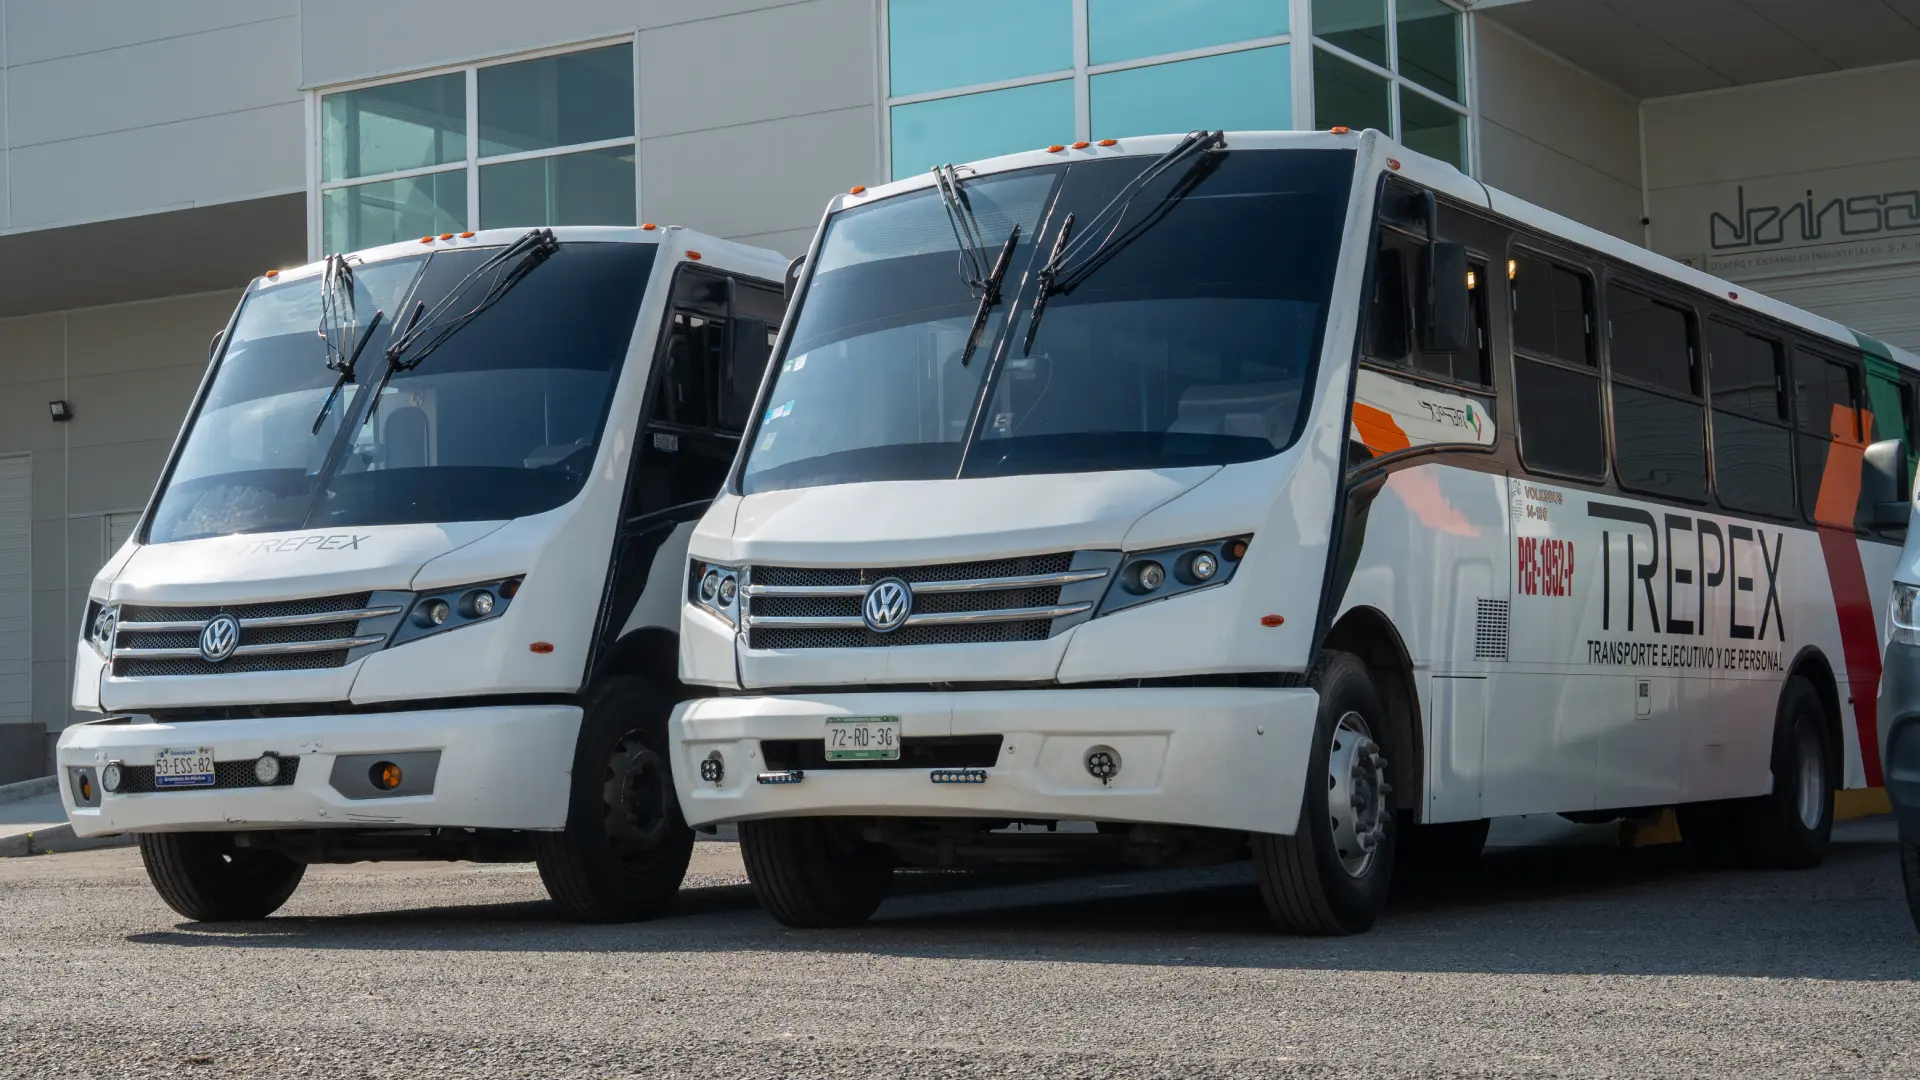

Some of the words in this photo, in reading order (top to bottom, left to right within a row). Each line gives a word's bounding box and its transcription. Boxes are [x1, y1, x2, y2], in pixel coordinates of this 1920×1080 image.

[1524, 485, 1563, 505] VOLKSBUS
[237, 534, 373, 556] TREPEX
[1518, 536, 1575, 597] PCE-1952-P
[1587, 501, 1786, 642] TREPEX
[1587, 640, 1659, 666] TRANSPORTE
[1661, 644, 1714, 669] EJECUTIVO
[1715, 647, 1723, 669] Y
[1724, 648, 1736, 669] DE
[1738, 649, 1784, 672] PERSONAL
[156, 756, 212, 775] 53-ESS-82
